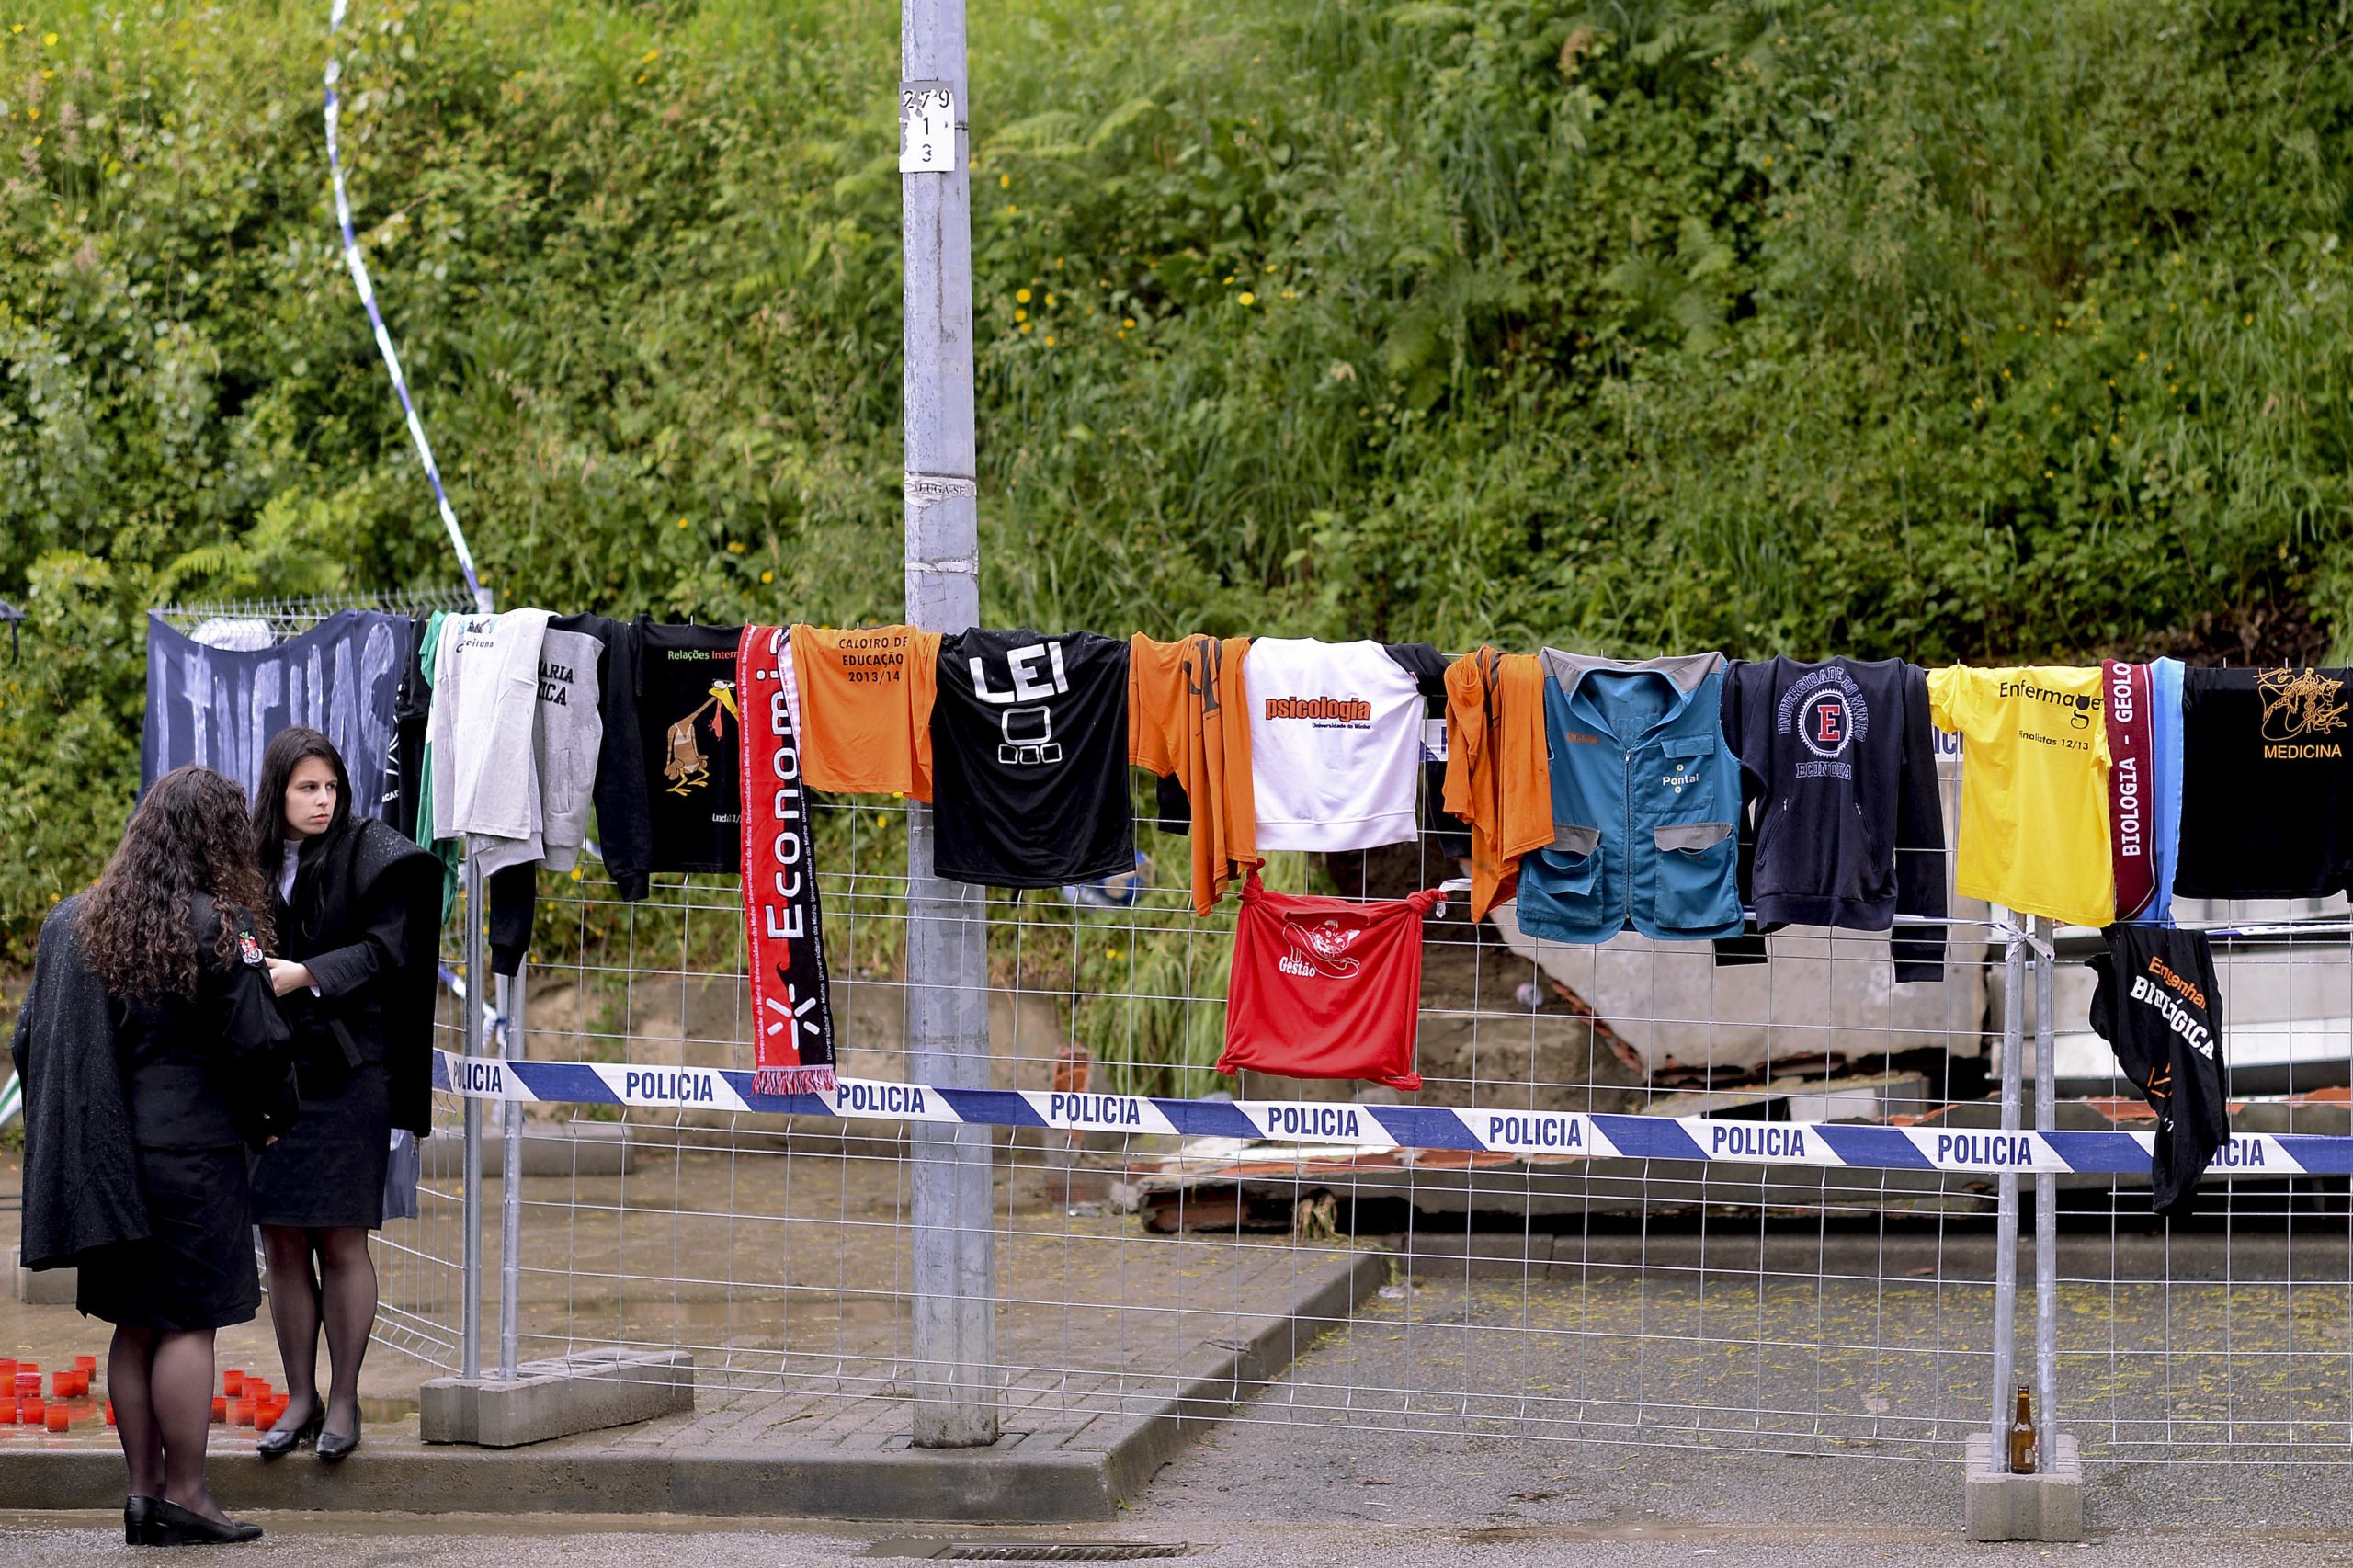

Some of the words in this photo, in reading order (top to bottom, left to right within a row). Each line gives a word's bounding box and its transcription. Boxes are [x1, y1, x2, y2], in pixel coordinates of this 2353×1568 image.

[923, 117, 929, 135] 1
[922, 143, 932, 162] 3
[839, 637, 889, 649] CALOIRO
[667, 649, 710, 661] Relações
[842, 651, 904, 668] EDUCAÇÃO
[848, 671, 901, 686] 2013/14
[969, 642, 1069, 703] LEI
[1840, 673, 1859, 697] DO
[2112, 662, 2133, 723] GEOLO
[1266, 696, 1371, 723] psicologia
[1777, 665, 1845, 735] UNIVERSIDADE
[1999, 679, 2104, 730] Enfermage
[1817, 704, 1841, 742] E
[1849, 693, 1870, 743] MINHO
[2061, 738, 2089, 751] 12/13
[2264, 744, 2343, 759] MEDICINA
[1662, 772, 1699, 787] Pontal
[2119, 757, 2141, 856] BIOLOGIA
[1279, 956, 1316, 977] Gestão
[453, 1060, 503, 1093] POLICIA
[626, 1071, 713, 1102] POLICIA
[836, 1083, 926, 1114] POLICIA
[1051, 1093, 1141, 1125] POLICIA
[1267, 1107, 1360, 1137] POLICIA
[1489, 1116, 1583, 1147] POLICIA
[1712, 1126, 1806, 1157] POLICIA
[1938, 1134, 2033, 1165] POLICIA
